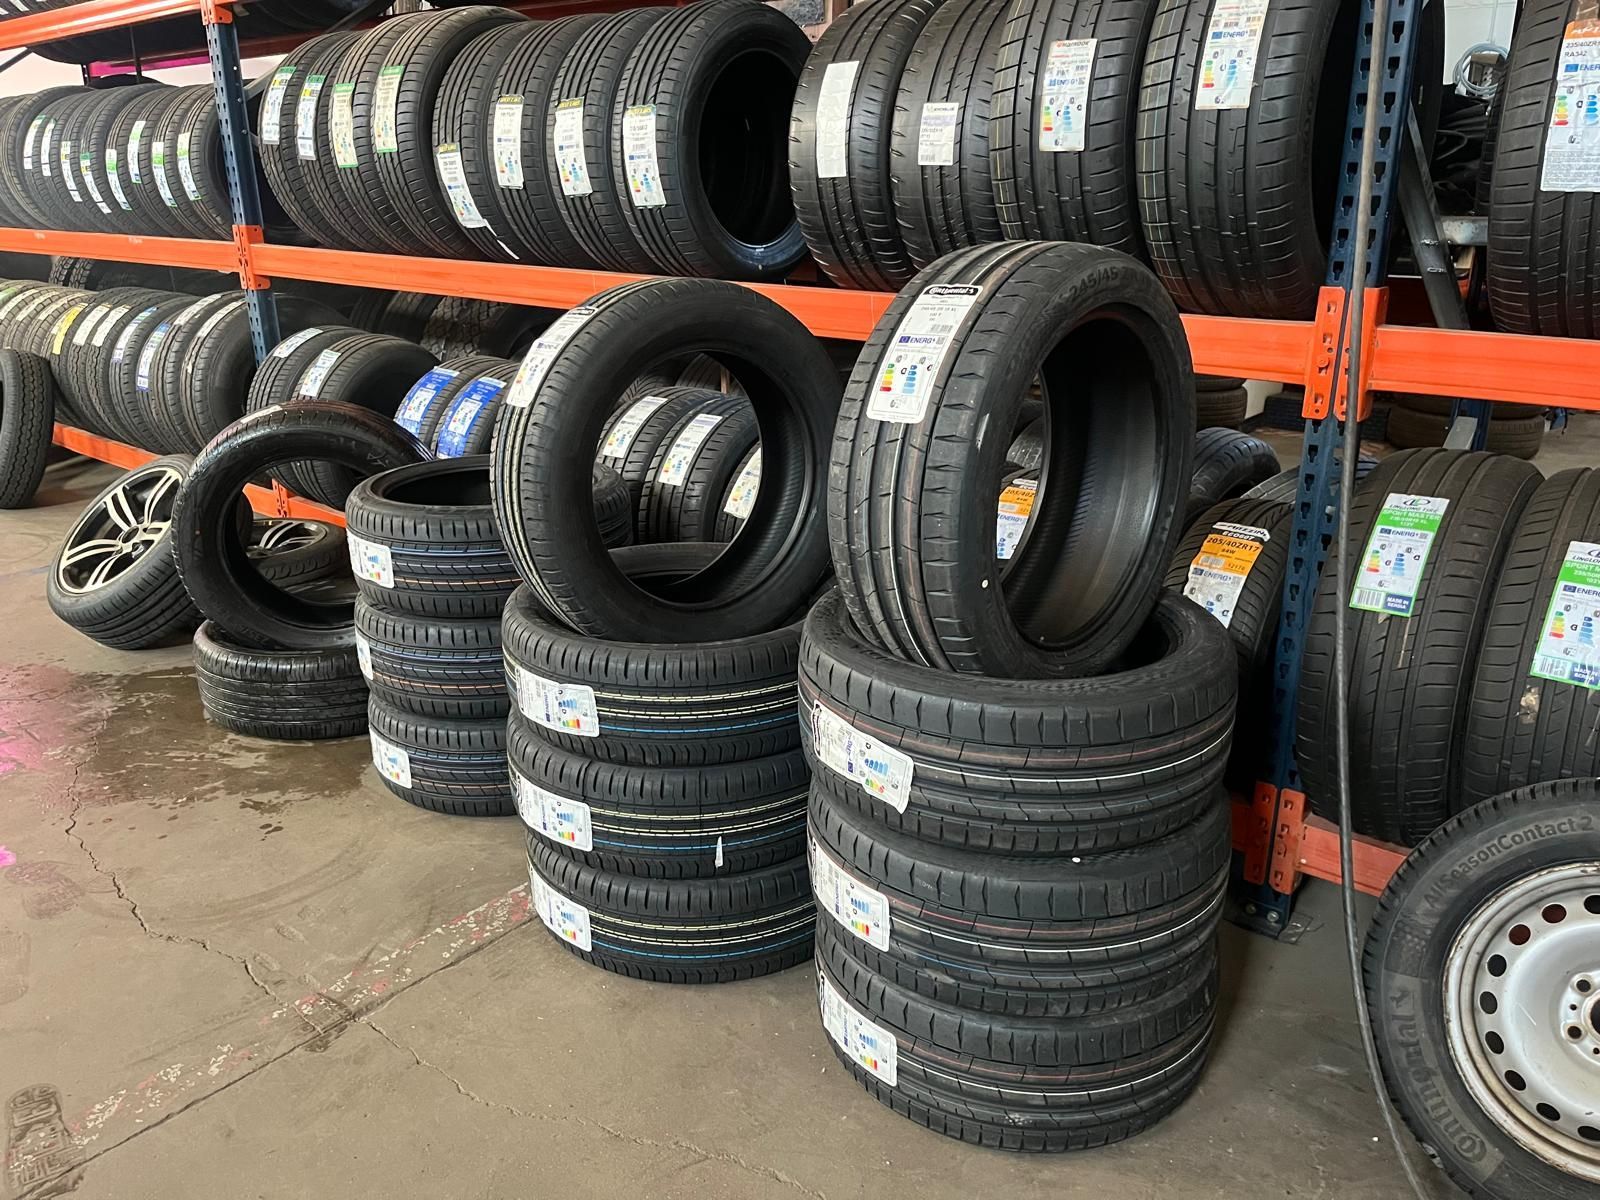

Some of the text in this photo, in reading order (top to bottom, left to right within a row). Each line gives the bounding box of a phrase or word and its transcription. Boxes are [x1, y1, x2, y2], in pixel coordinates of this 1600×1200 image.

[928, 286, 967, 295] Continental
[1069, 266, 1119, 302] 245/45
[910, 336, 933, 344] ENERG
[1391, 529, 1416, 538] ENERG
[1206, 537, 1260, 552] 205/40ZR17
[1423, 815, 1595, 909] AllSeasonContact 2
[1389, 1012, 1488, 1164] Continental
